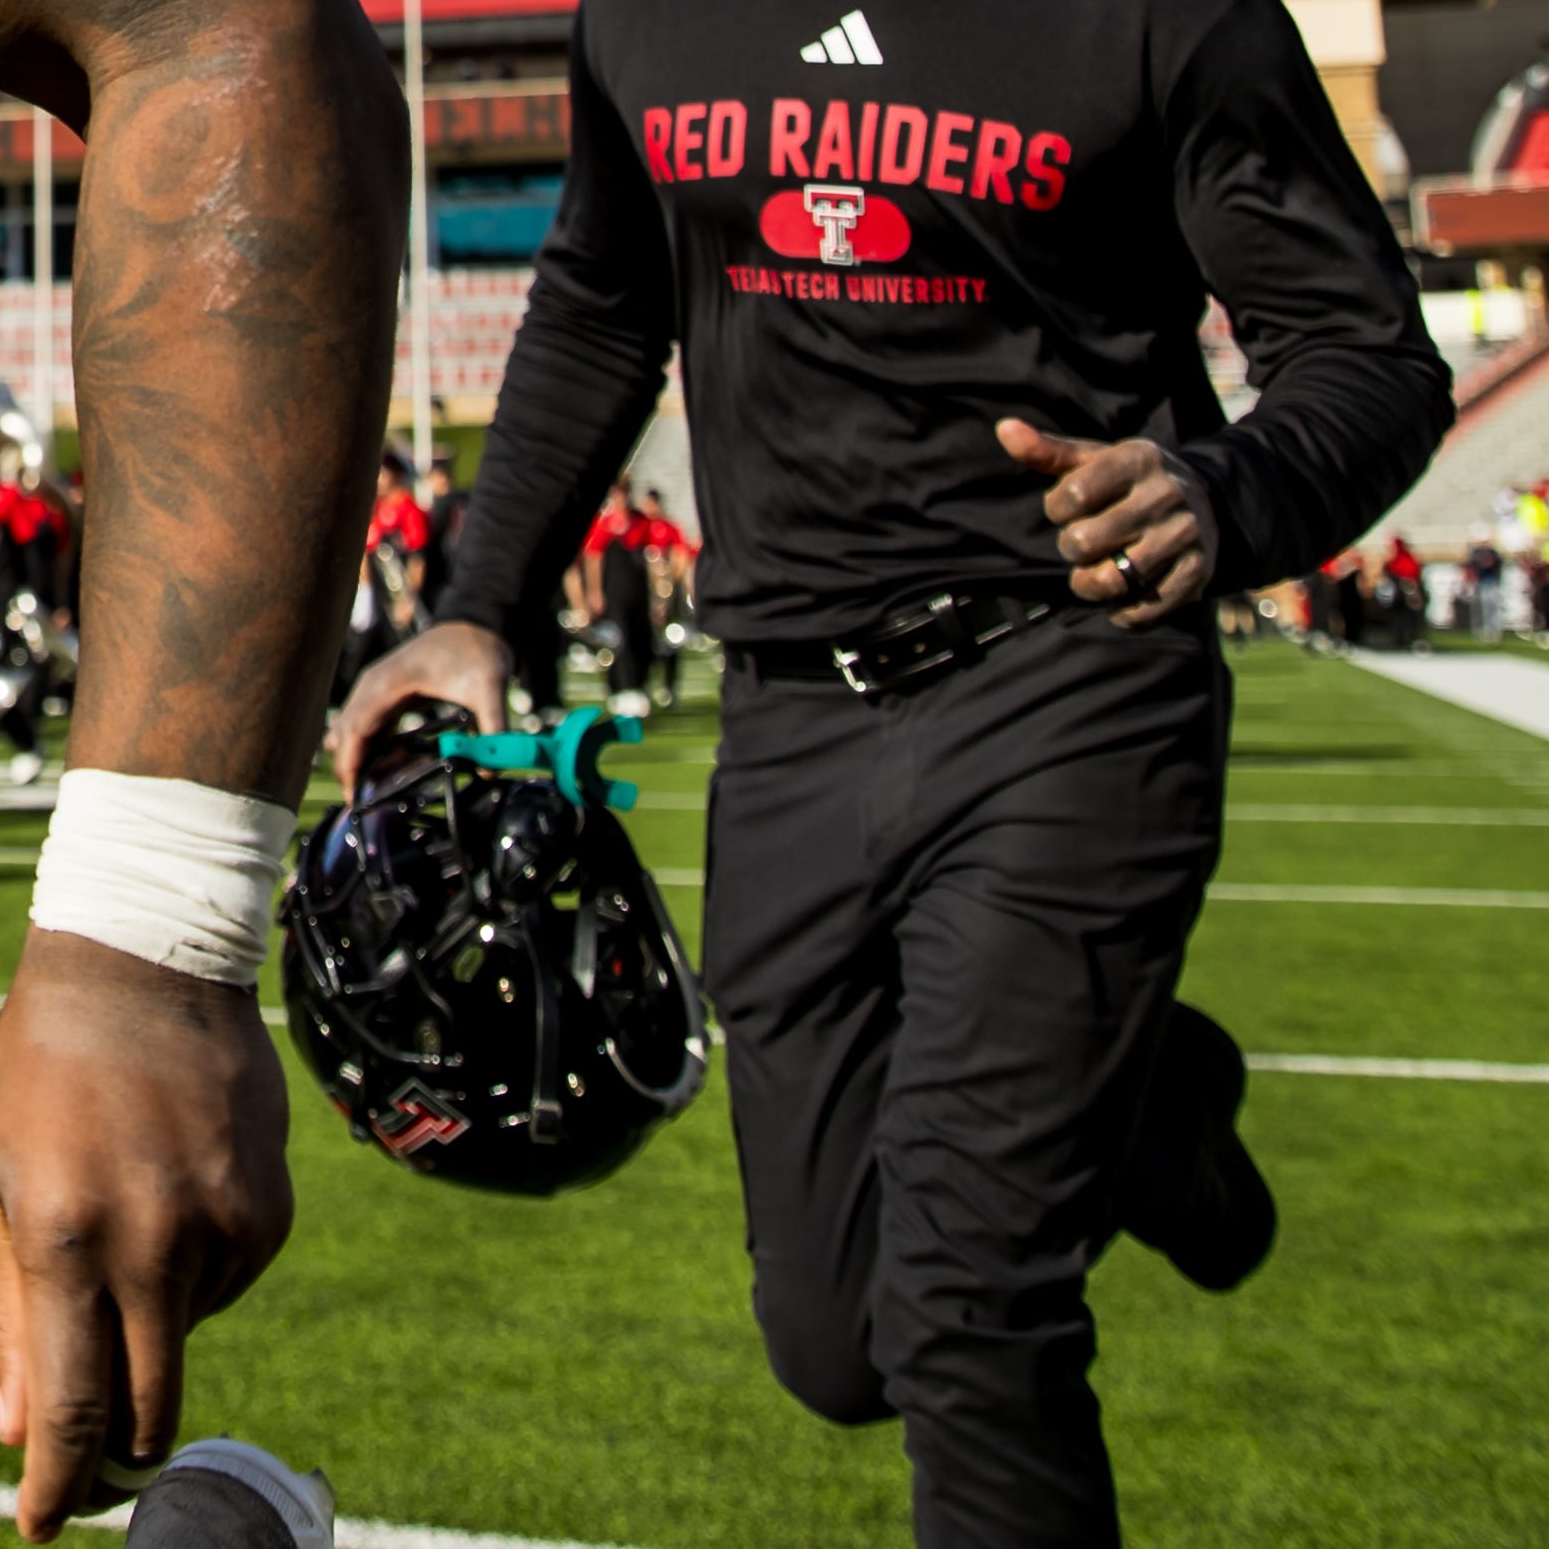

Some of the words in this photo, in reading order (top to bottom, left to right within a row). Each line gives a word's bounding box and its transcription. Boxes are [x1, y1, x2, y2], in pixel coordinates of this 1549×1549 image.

[643, 98, 748, 184] RED
[769, 97, 1072, 212] RAIDERS
[782, 270, 840, 300] TECH
[845, 274, 986, 304] UNIVERSITY
